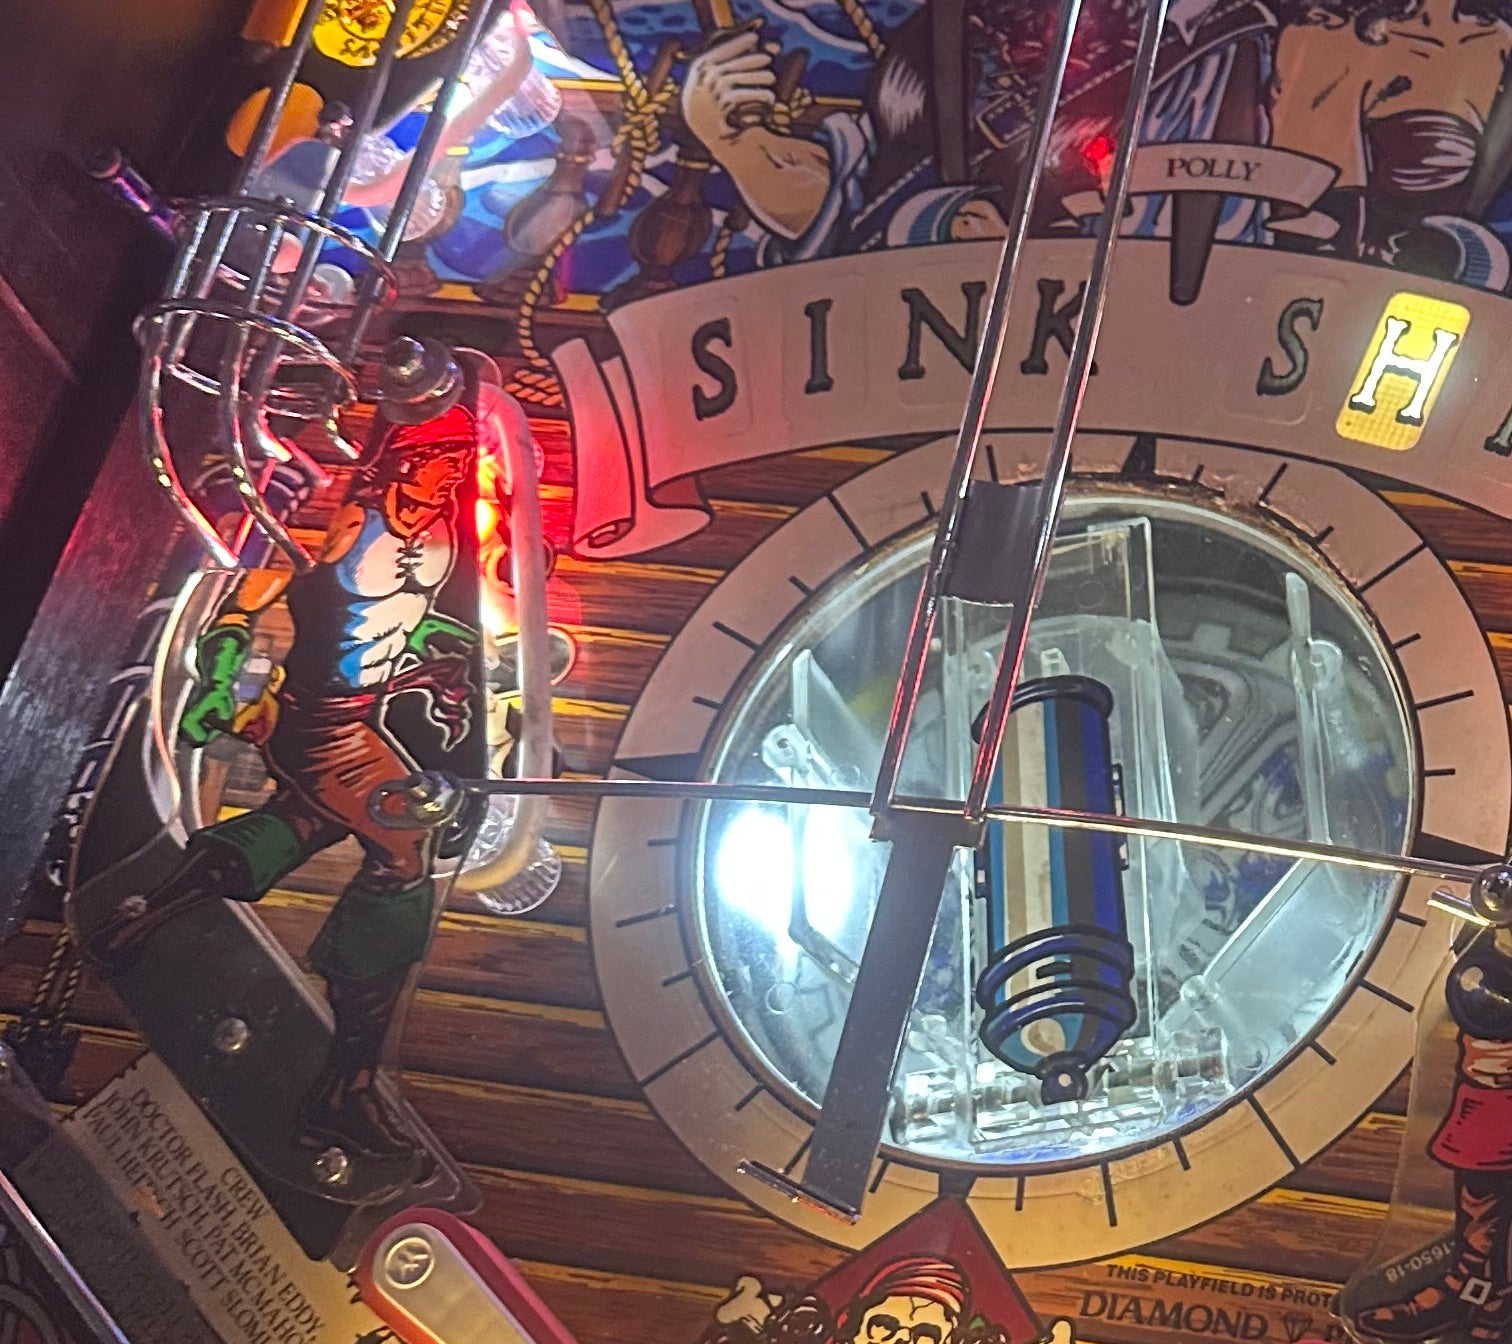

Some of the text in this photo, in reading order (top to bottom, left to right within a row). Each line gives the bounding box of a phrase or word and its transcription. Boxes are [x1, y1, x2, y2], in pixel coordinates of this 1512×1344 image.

[1166, 157, 1262, 184] POLLY
[691, 278, 1098, 421] SINK
[83, 1106, 121, 1158] PAUL
[180, 1228, 228, 1294] SCOTT
[101, 1090, 143, 1143] JOHN
[203, 1223, 243, 1265] PAT
[130, 1087, 195, 1160] DOCTOR
[231, 1220, 288, 1287] BRIAN
[219, 1165, 272, 1222] CREW
[1079, 1290, 1269, 1341] DIAMOND
[1106, 1263, 1333, 1309] THIS PLAYFIELD IS PROT
